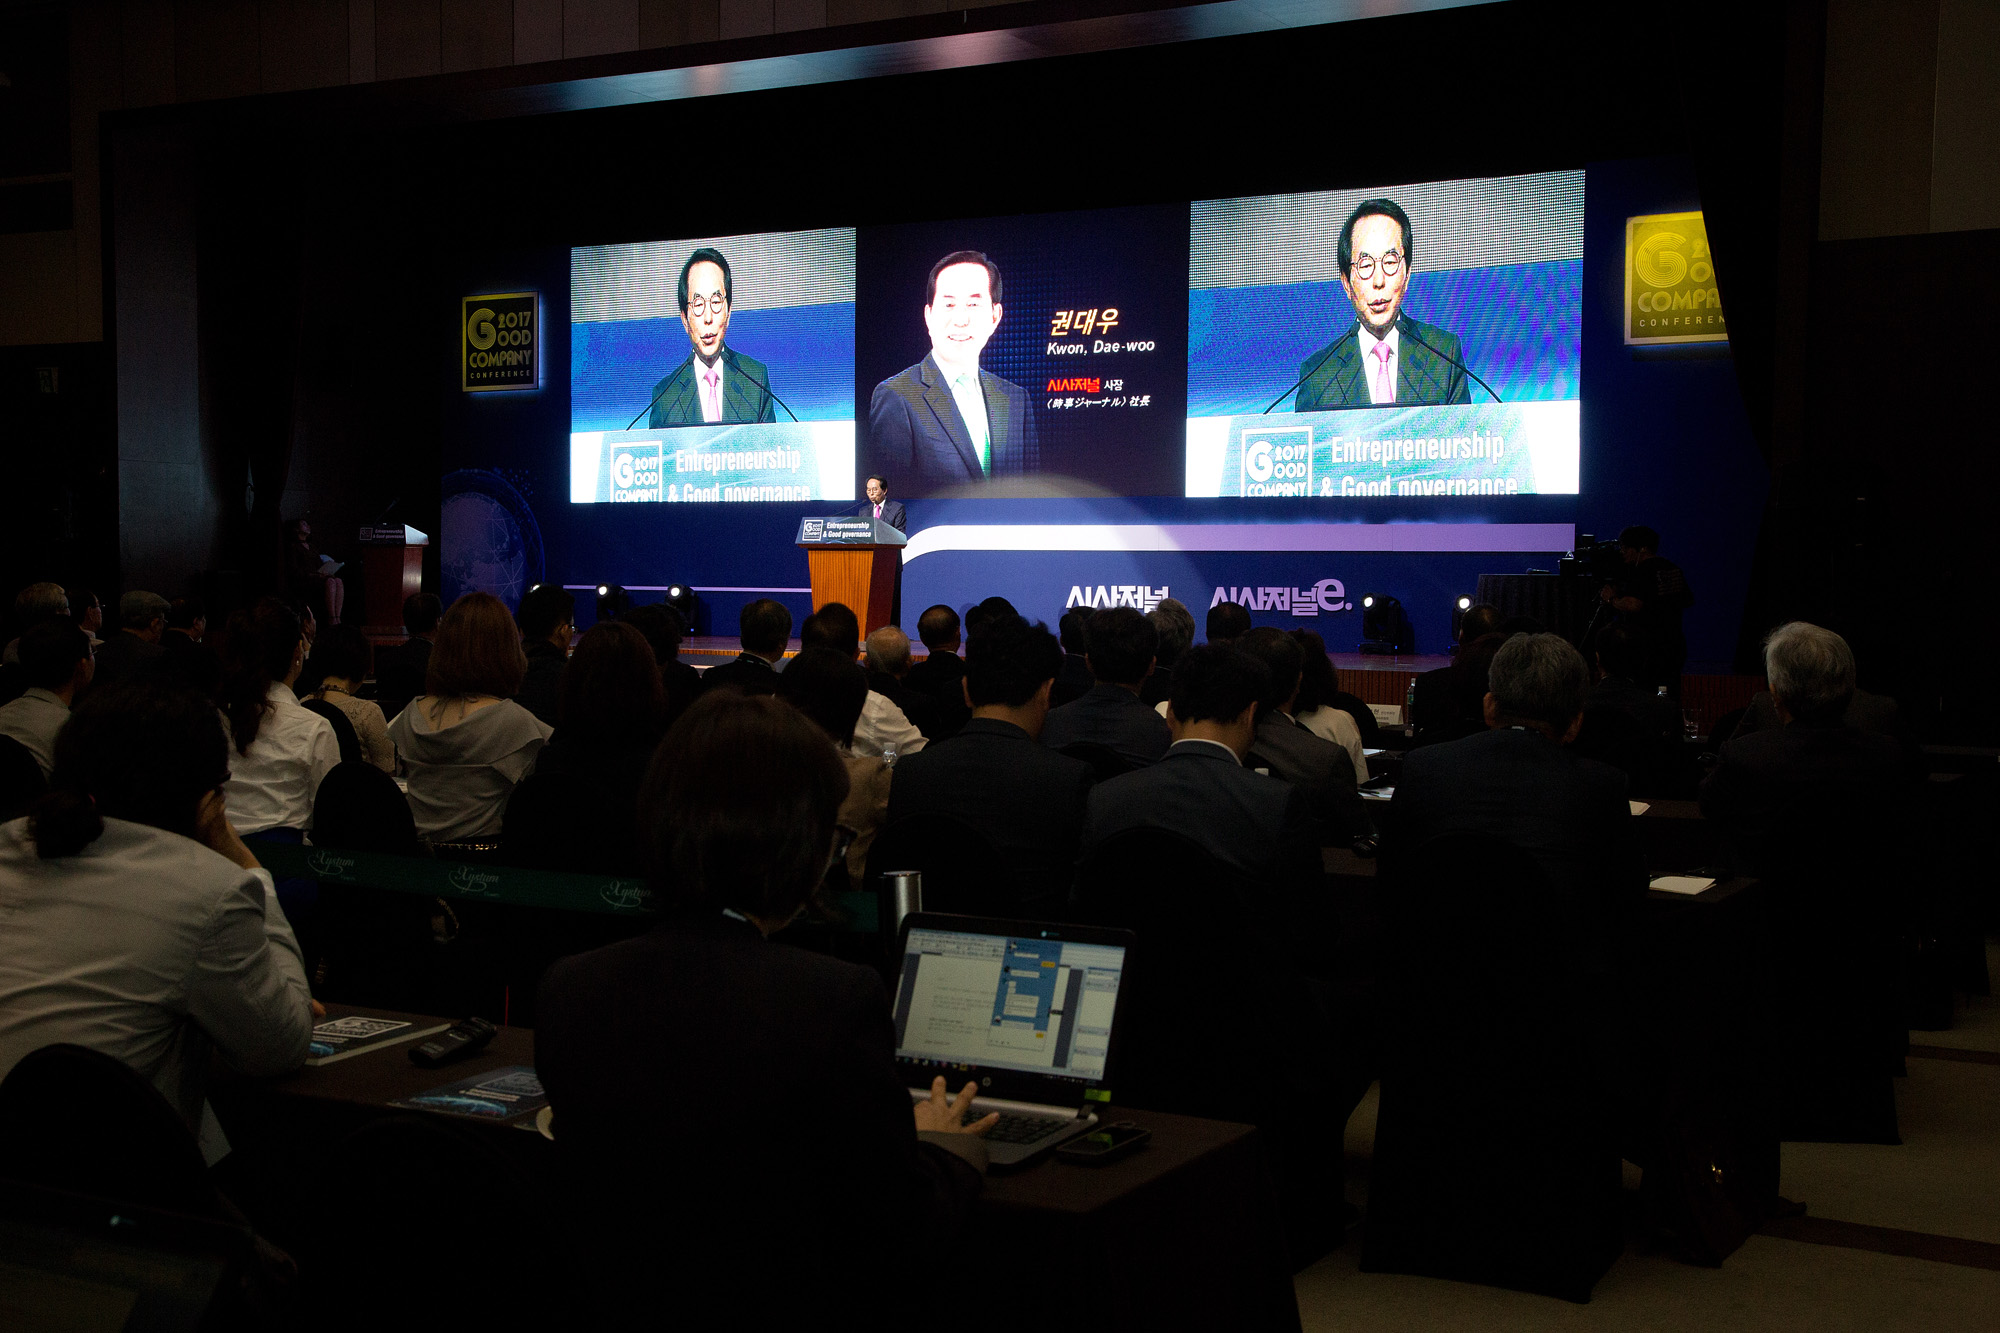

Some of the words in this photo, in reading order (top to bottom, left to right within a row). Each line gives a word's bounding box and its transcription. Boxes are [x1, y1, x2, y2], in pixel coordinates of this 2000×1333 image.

[1638, 287, 1722, 312] COMPA
[497, 311, 531, 328] 2017
[1051, 308, 1118, 336] 권대우
[1639, 315, 1726, 327] CONFEREN
[1046, 342, 1087, 356] Kwon,
[1093, 340, 1155, 353] Dae-woo
[469, 349, 532, 368] COMPANY
[470, 369, 530, 379] CONFERENCE
[1046, 377, 1100, 393] 시사저널
[1103, 379, 1124, 391] 사장
[1274, 444, 1307, 461] 2017
[1331, 430, 1504, 468] Entrepreneurship
[634, 456, 659, 471] 2017
[675, 446, 801, 476] Entrepreneurship
[667, 483, 679, 502] &
[683, 482, 720, 502] Good
[1247, 481, 1307, 497] COMPANY
[1319, 476, 1334, 497] &
[1341, 474, 1391, 496] Good
[615, 488, 658, 502] COMPANY
[827, 522, 870, 530] Entrepreneurship
[1065, 585, 1170, 614] 시사저널
